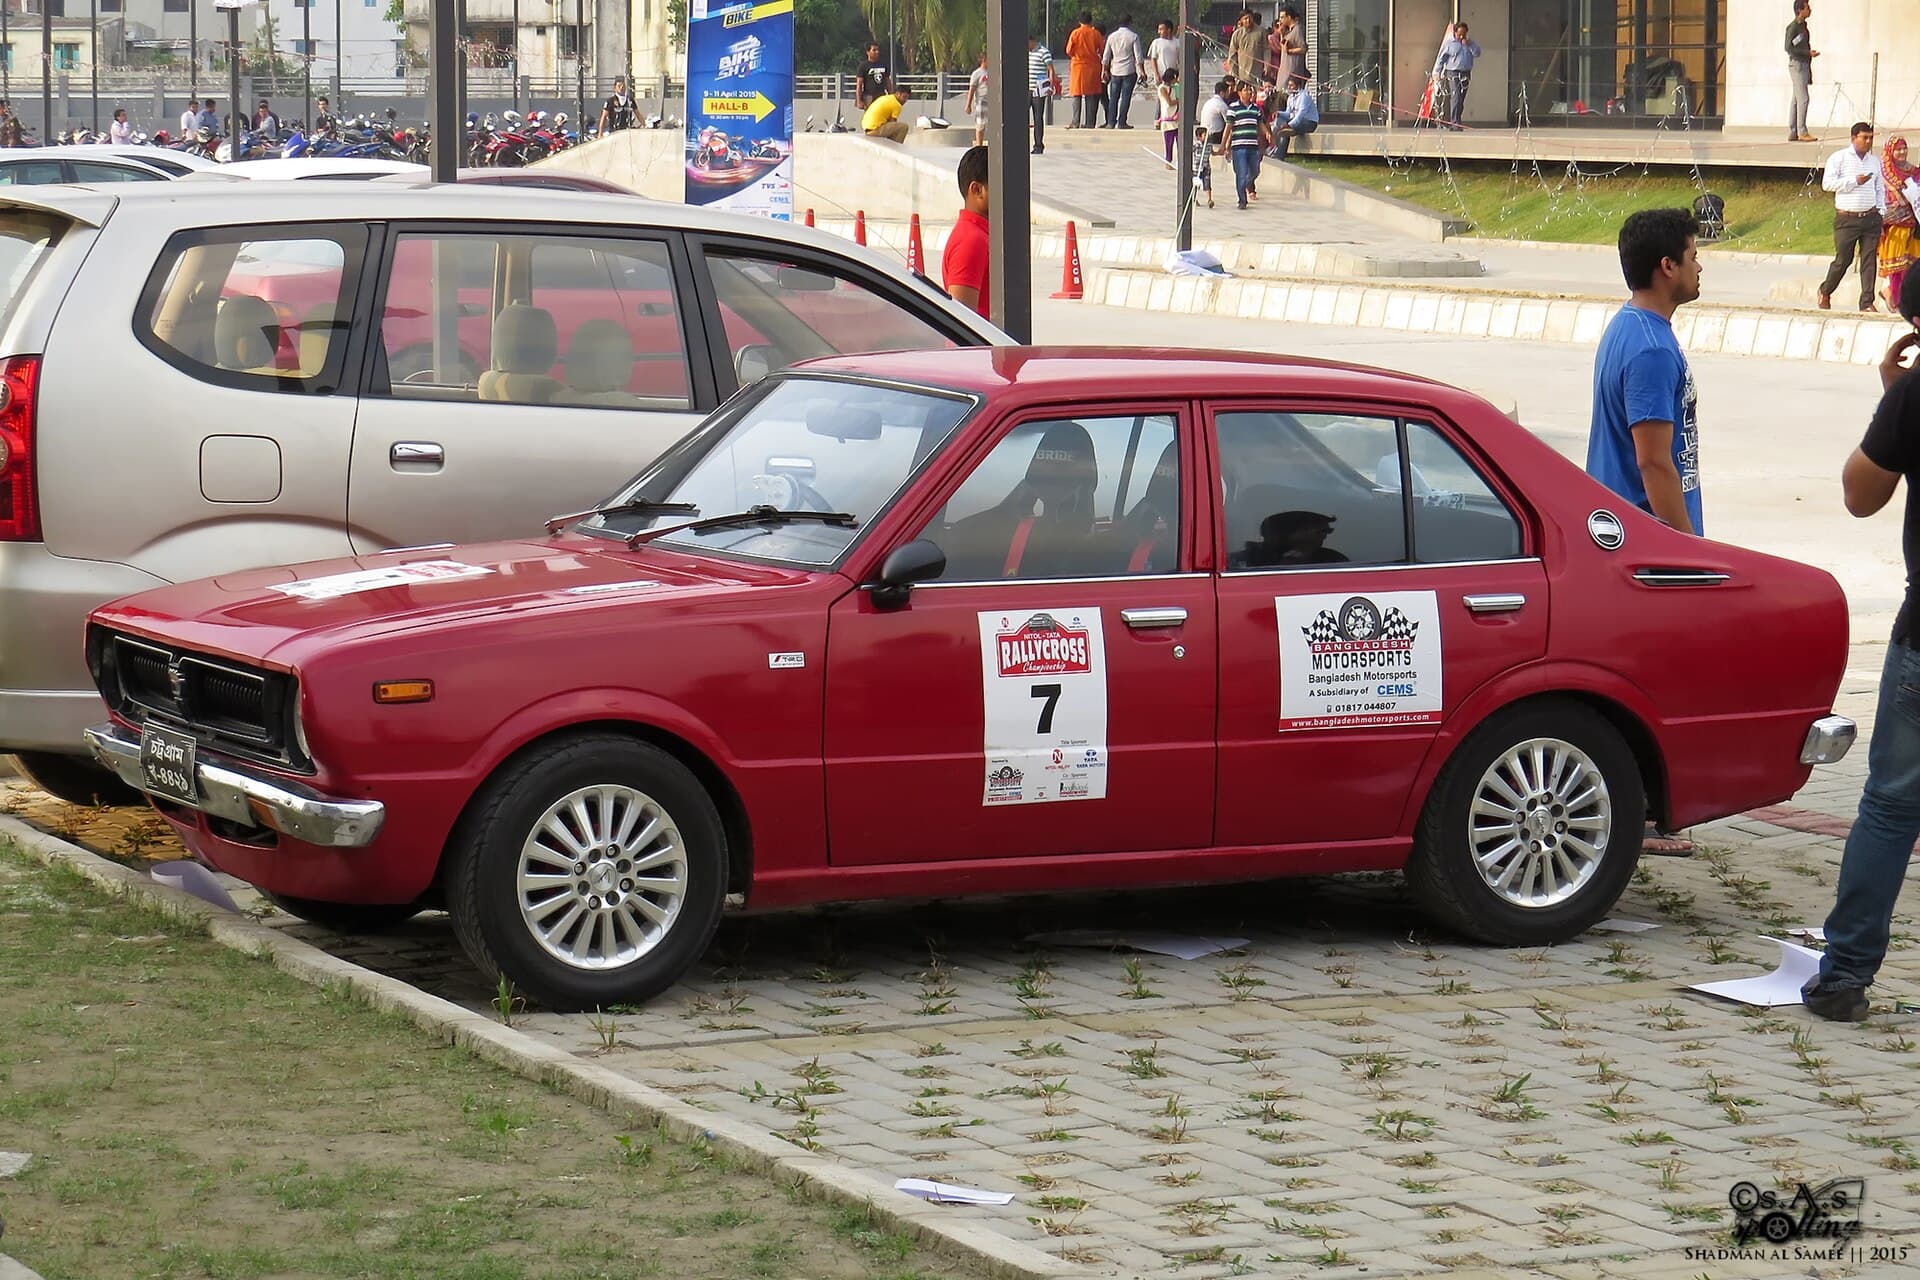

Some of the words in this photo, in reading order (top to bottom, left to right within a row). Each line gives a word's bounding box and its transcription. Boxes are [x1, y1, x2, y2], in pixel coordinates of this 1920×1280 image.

[726, 10, 753, 25] BIKE
[719, 47, 763, 70] BIKE
[721, 90, 738, 98] April
[739, 90, 756, 98] 2015
[711, 102, 749, 111] HALL-B
[1314, 641, 1408, 652] BANGLADESH
[1001, 638, 1086, 669] RALLYCROSS
[1312, 650, 1412, 670] MOTORSPORTS
[1023, 661, 1066, 673] Championship
[1308, 672, 1361, 684] Bangladesh
[1363, 671, 1417, 682] Motorsports
[1316, 687, 1359, 696] Subsidiary
[1377, 684, 1413, 695] CEMS
[1030, 684, 1062, 734] 7
[1335, 704, 1361, 712] 01817
[1364, 702, 1396, 710] 044807
[1291, 714, 1429, 727] www.bangladeshmotorsports.com
